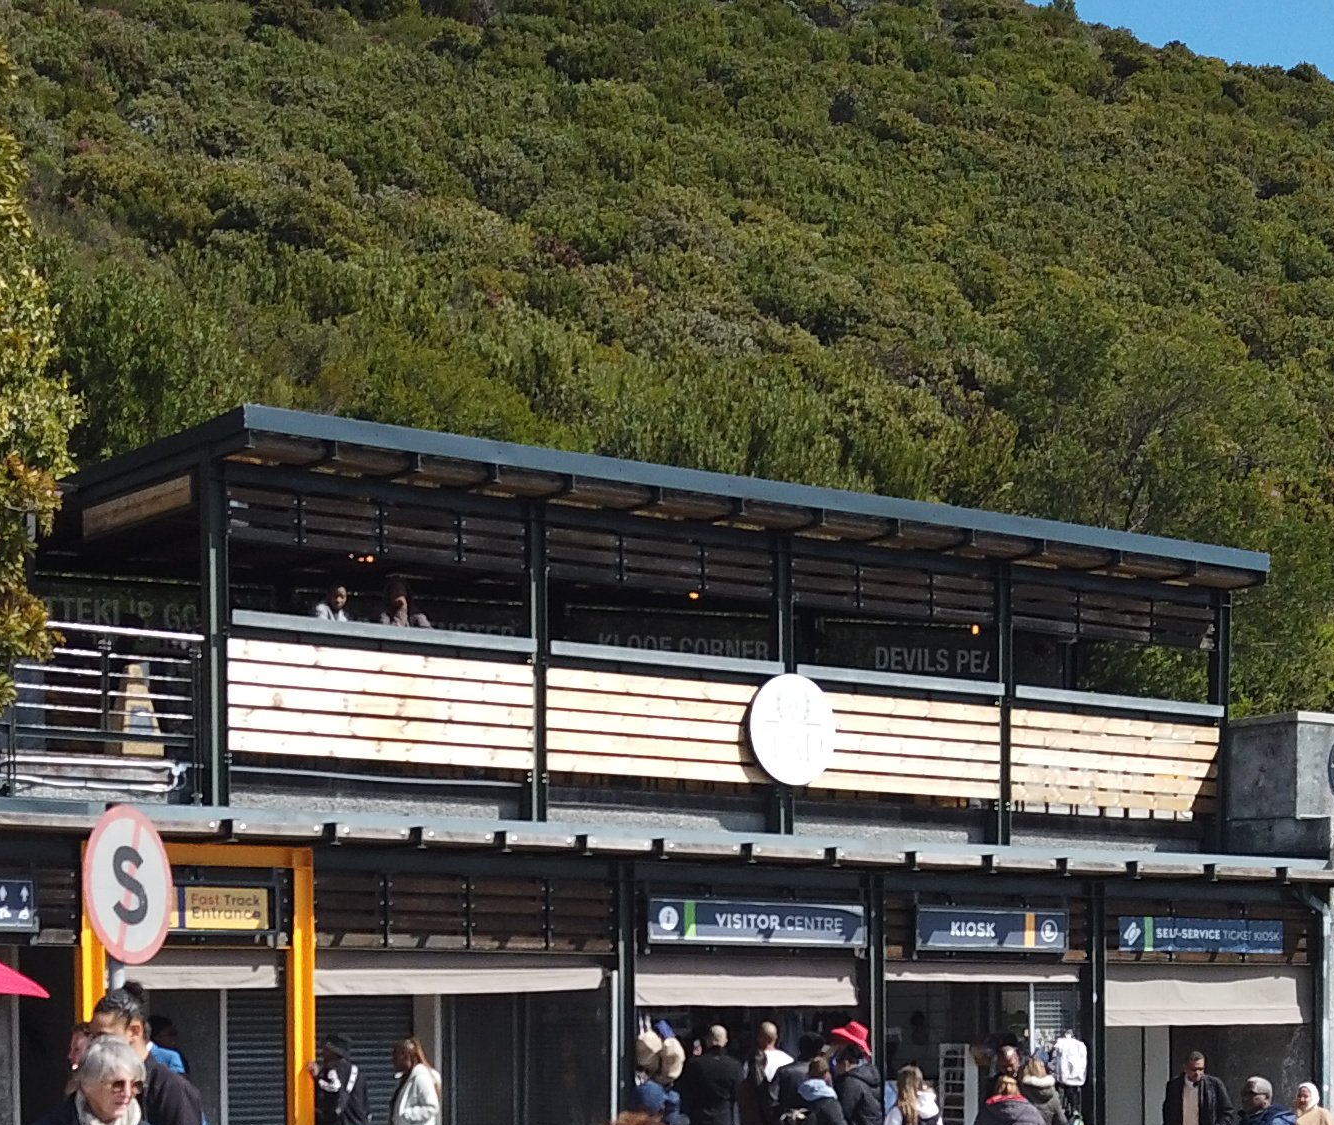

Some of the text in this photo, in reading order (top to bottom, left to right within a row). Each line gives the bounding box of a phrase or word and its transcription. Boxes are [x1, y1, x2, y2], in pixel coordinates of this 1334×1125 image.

[875, 646, 949, 672] DEVILS
[112, 846, 148, 925] S
[191, 893, 260, 906] Fast Track
[191, 906, 261, 920] Entrance
[715, 913, 844, 932] VISITOR CENTRE
[950, 921, 996, 938] KIOSK
[1155, 927, 1280, 942] SELF-SERVICE TICKET KIOSK
